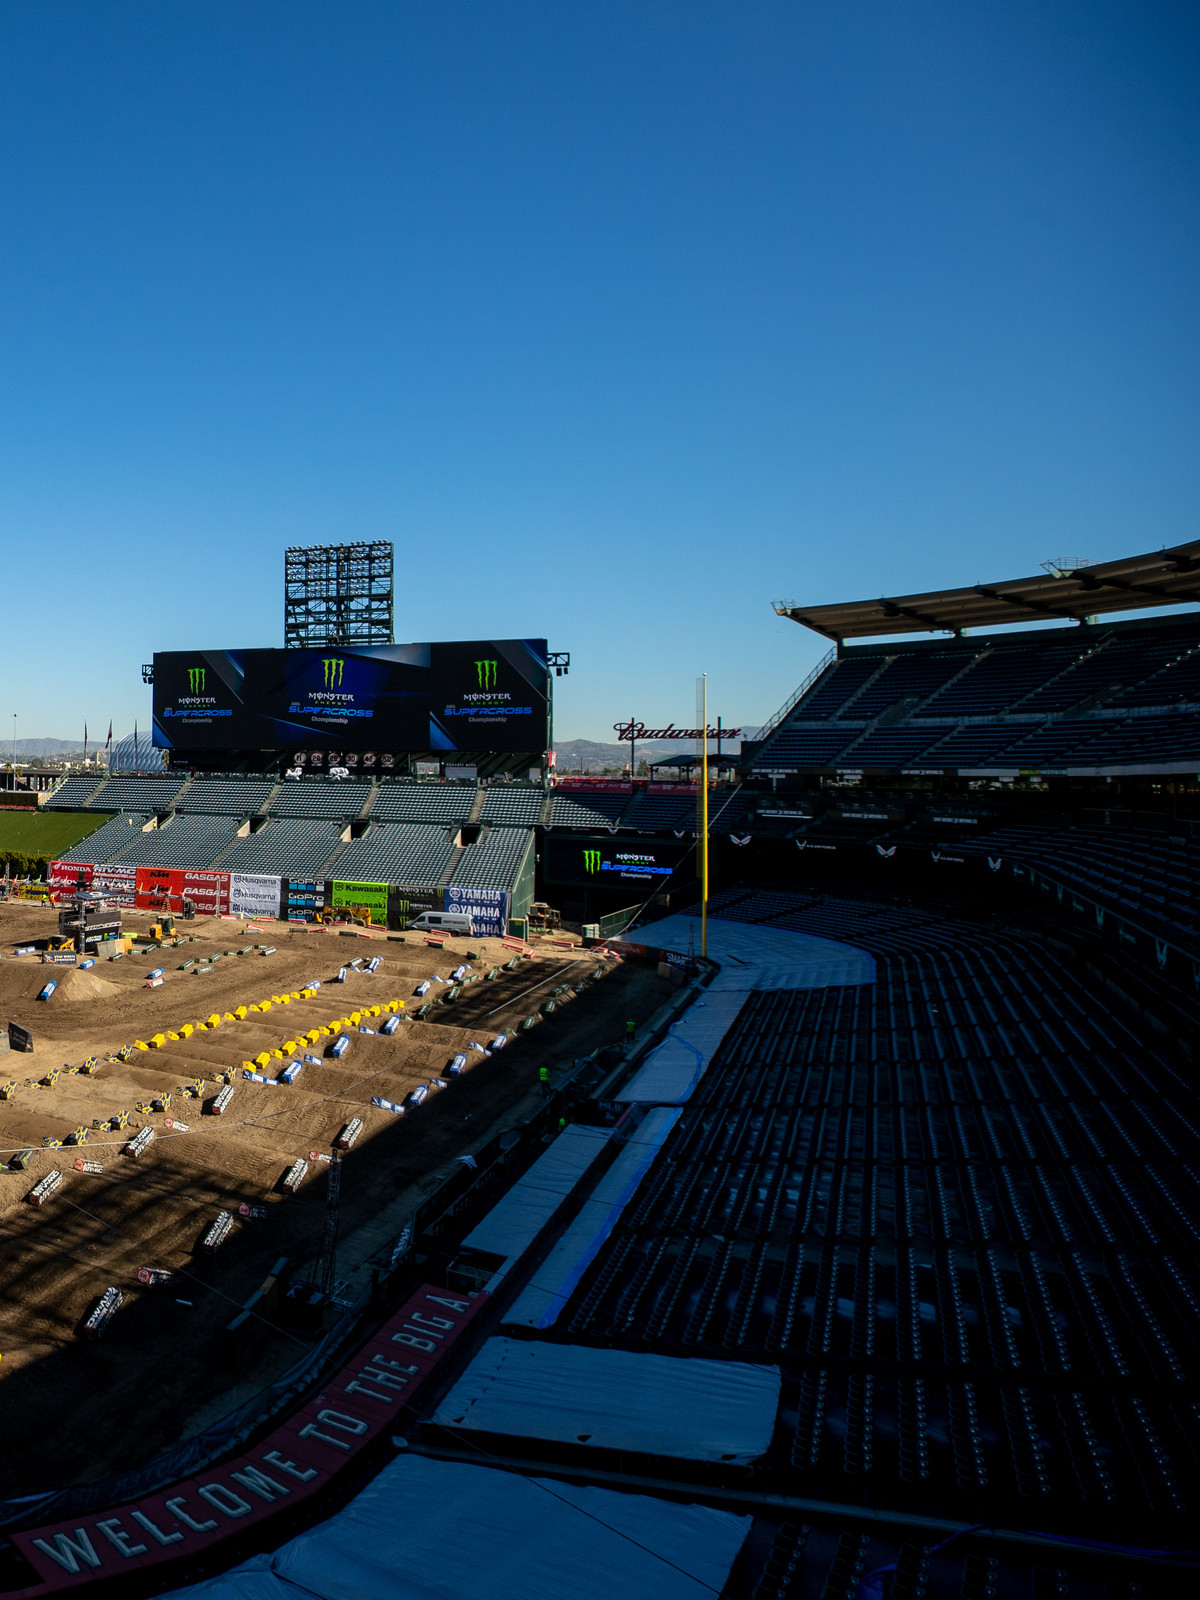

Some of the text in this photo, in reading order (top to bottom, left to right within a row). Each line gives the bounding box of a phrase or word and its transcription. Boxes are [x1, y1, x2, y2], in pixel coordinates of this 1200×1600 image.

[308, 692, 355, 701] MONSTER
[463, 693, 512, 701] MONSTER
[163, 709, 232, 718] SUPERCROSS
[288, 705, 374, 718] SUPERCROSS
[443, 706, 533, 716] SUPERCROSS
[613, 722, 741, 741] Budweiser
[616, 853, 655, 862] MONSTER
[601, 863, 673, 875] SUPERCROSS
[149, 870, 169, 878] KTM
[184, 872, 229, 881] GASGAS
[242, 876, 277, 885] Husqvarna
[289, 877, 325, 886] GoPro
[183, 887, 228, 897] GASGAS
[345, 884, 387, 893] Kawasaki
[399, 886, 434, 894] MONSTER
[241, 891, 277, 901] Husqvarna
[288, 892, 325, 901] GoPro
[460, 891, 501, 901] YAMAHA
[192, 903, 228, 912] ASGAS
[345, 900, 386, 909] Kawasaki
[460, 906, 500, 917] YAMAHA
[31, 1293, 472, 1576] WELCOME TO THE BIG A
